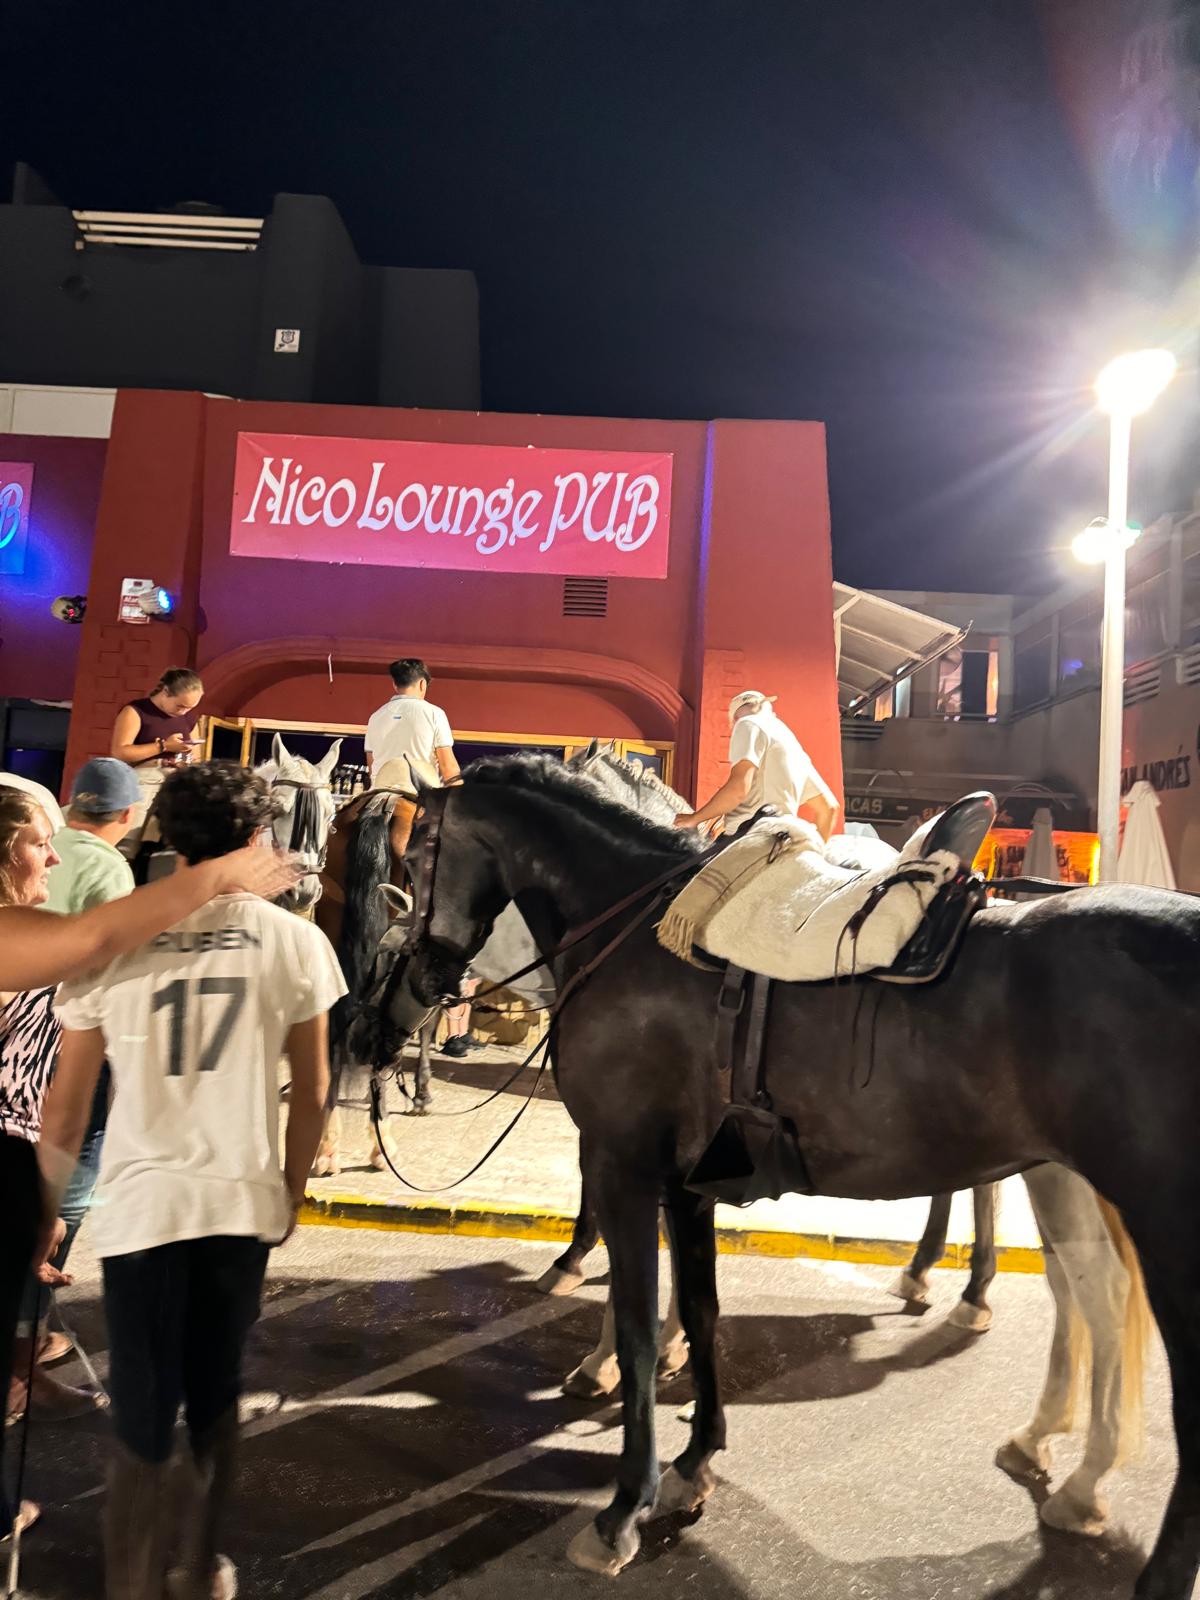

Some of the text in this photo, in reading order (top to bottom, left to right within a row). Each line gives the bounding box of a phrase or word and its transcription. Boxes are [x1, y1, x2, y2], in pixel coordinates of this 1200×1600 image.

[241, 457, 660, 555] Nico Lounge PUB
[151, 976, 248, 1076] 17
